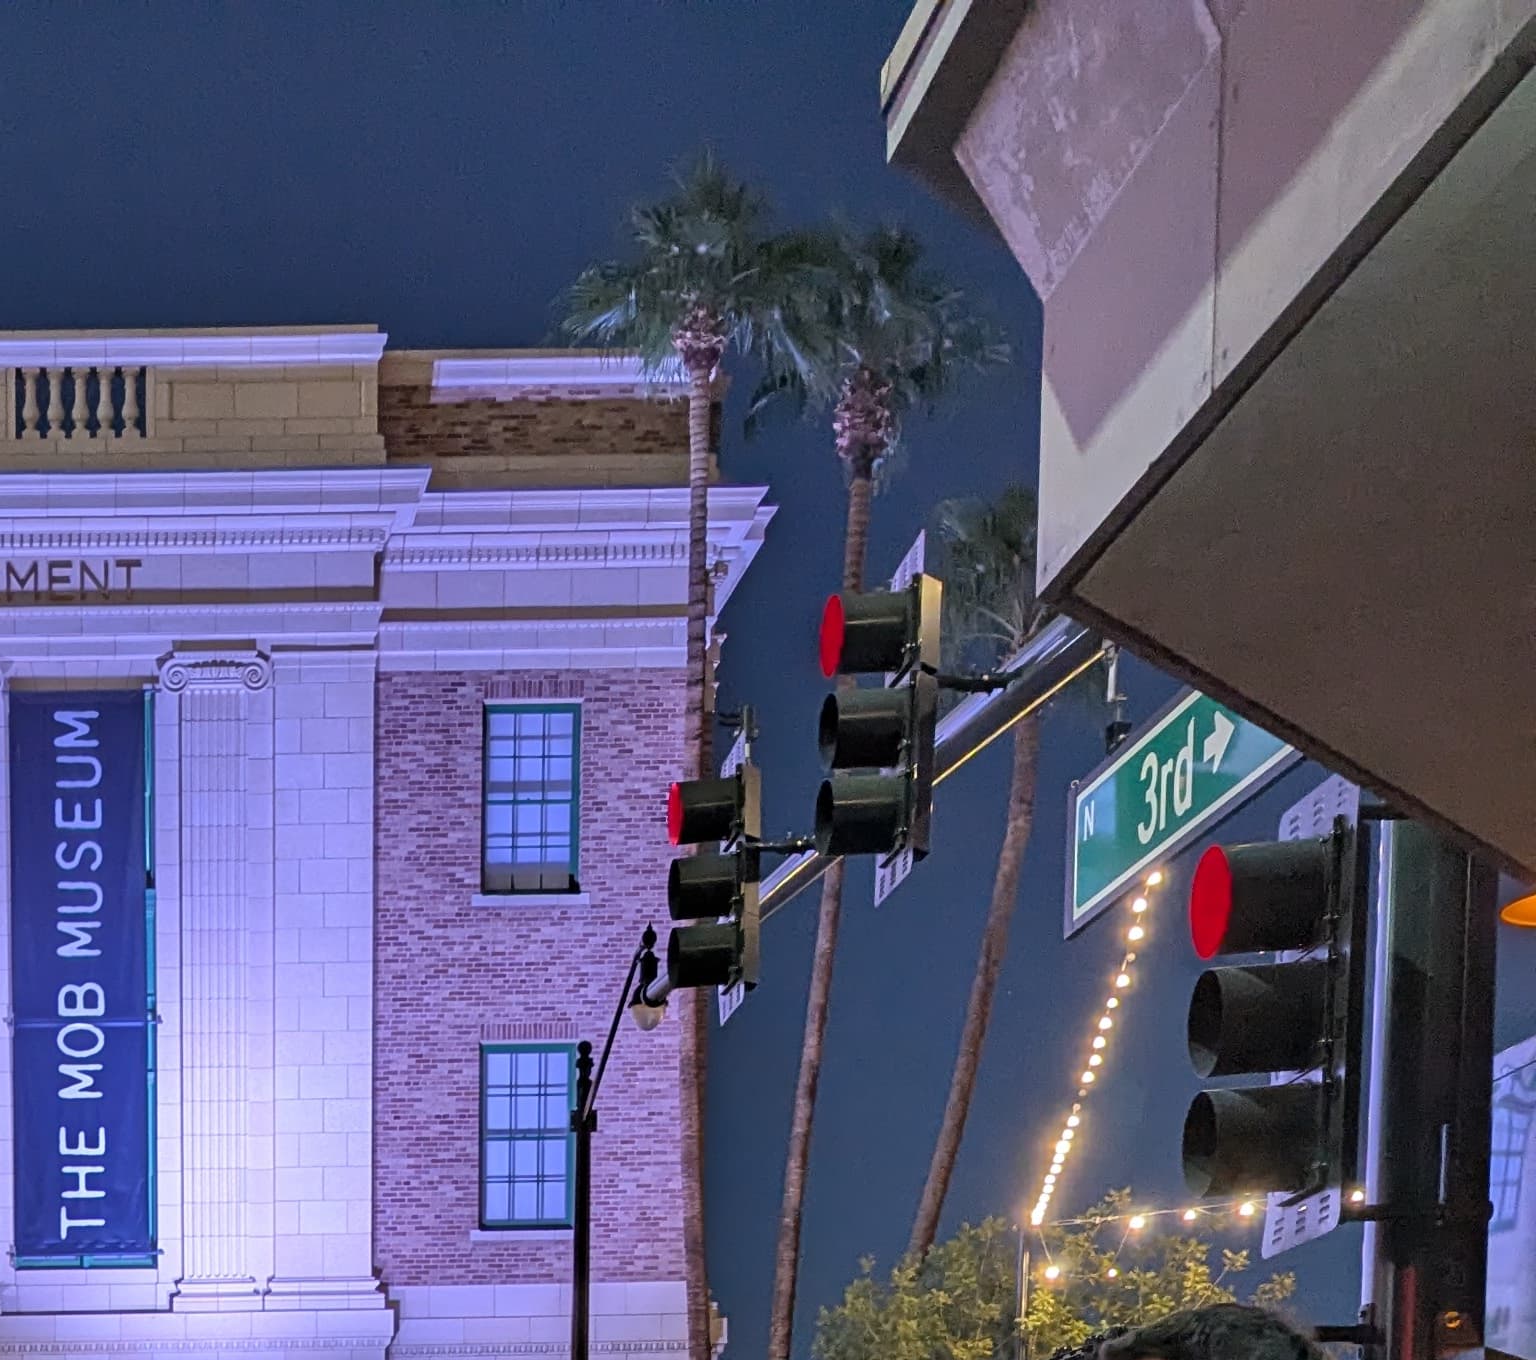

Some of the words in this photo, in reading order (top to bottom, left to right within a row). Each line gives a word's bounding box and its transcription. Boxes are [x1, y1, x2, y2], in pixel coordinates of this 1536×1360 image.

[54, 710, 102, 958] MUSEUM
[1083, 800, 1095, 842] N
[1137, 716, 1195, 844] 3rd
[57, 981, 105, 1100] MOB
[59, 1125, 106, 1241] THE
